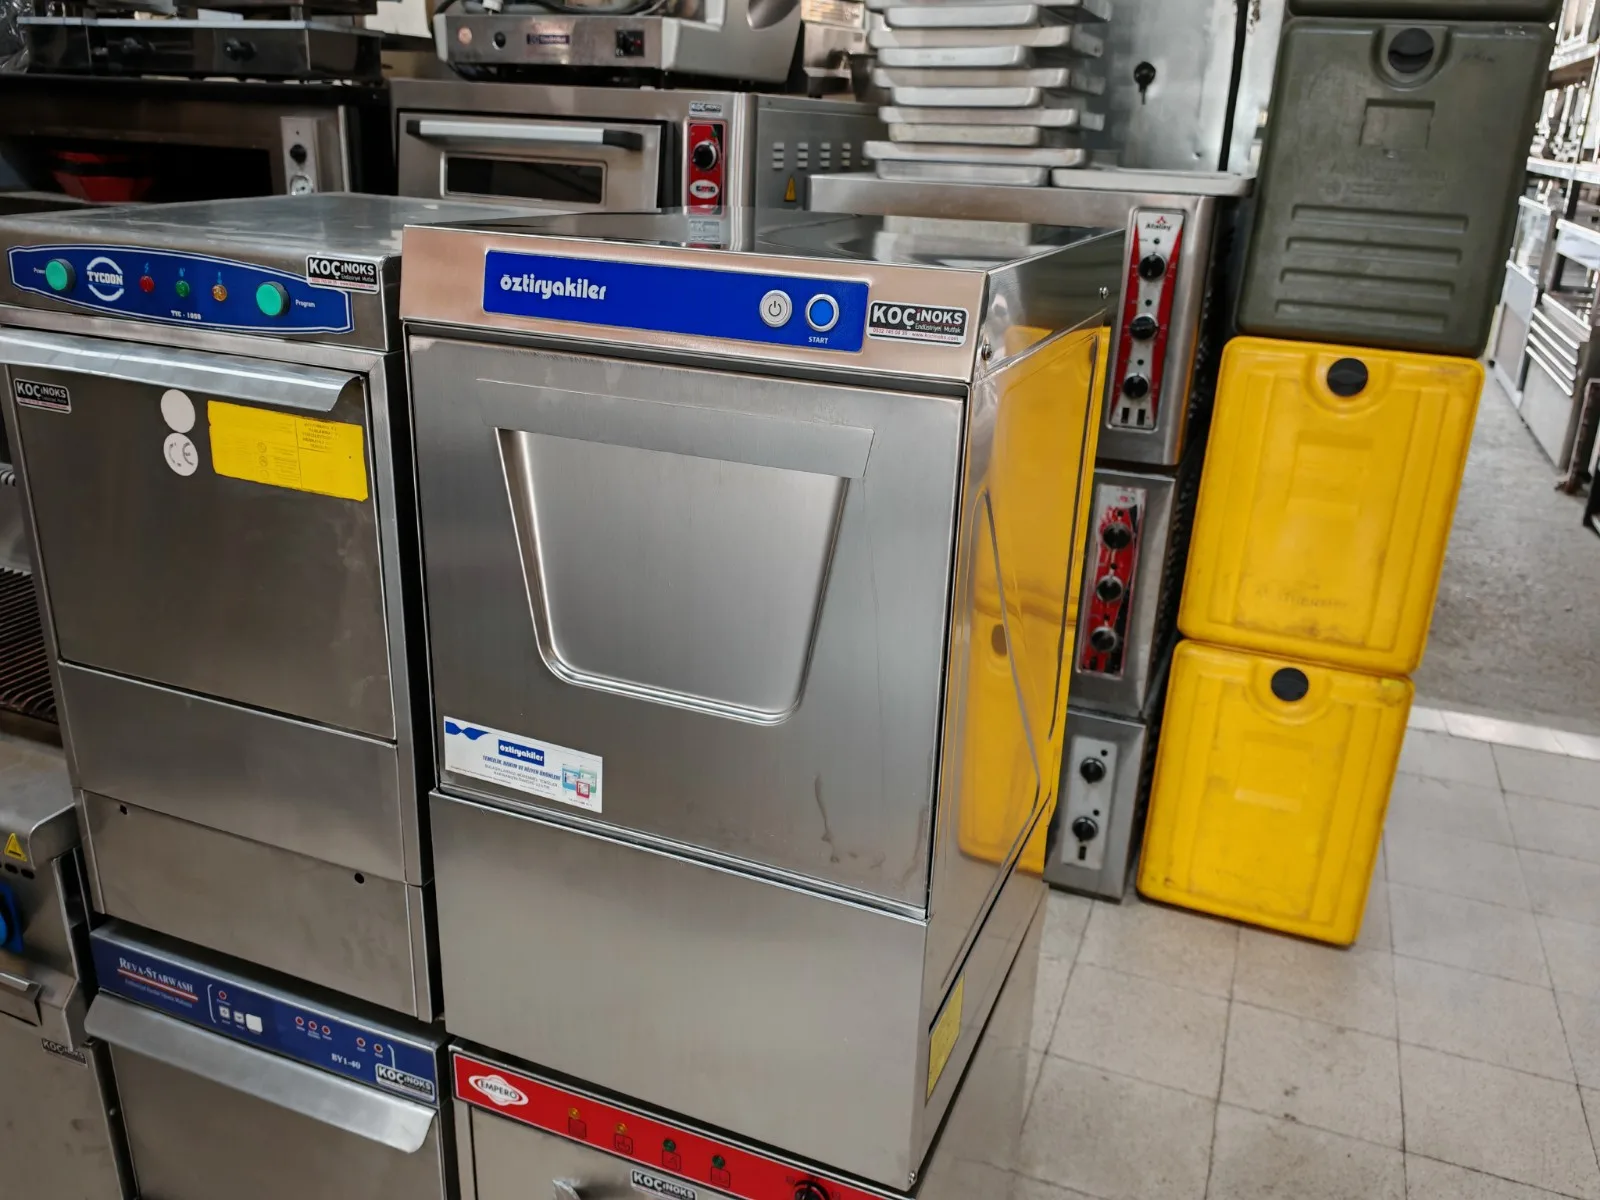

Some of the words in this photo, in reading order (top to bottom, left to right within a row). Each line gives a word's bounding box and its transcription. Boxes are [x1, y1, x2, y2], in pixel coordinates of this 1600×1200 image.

[86, 271, 124, 286] TYCOON
[500, 273, 606, 301] öztiryakiler
[295, 299, 316, 308] Program
[808, 336, 829, 344] START
[480, 1080, 518, 1099] EMPERO
